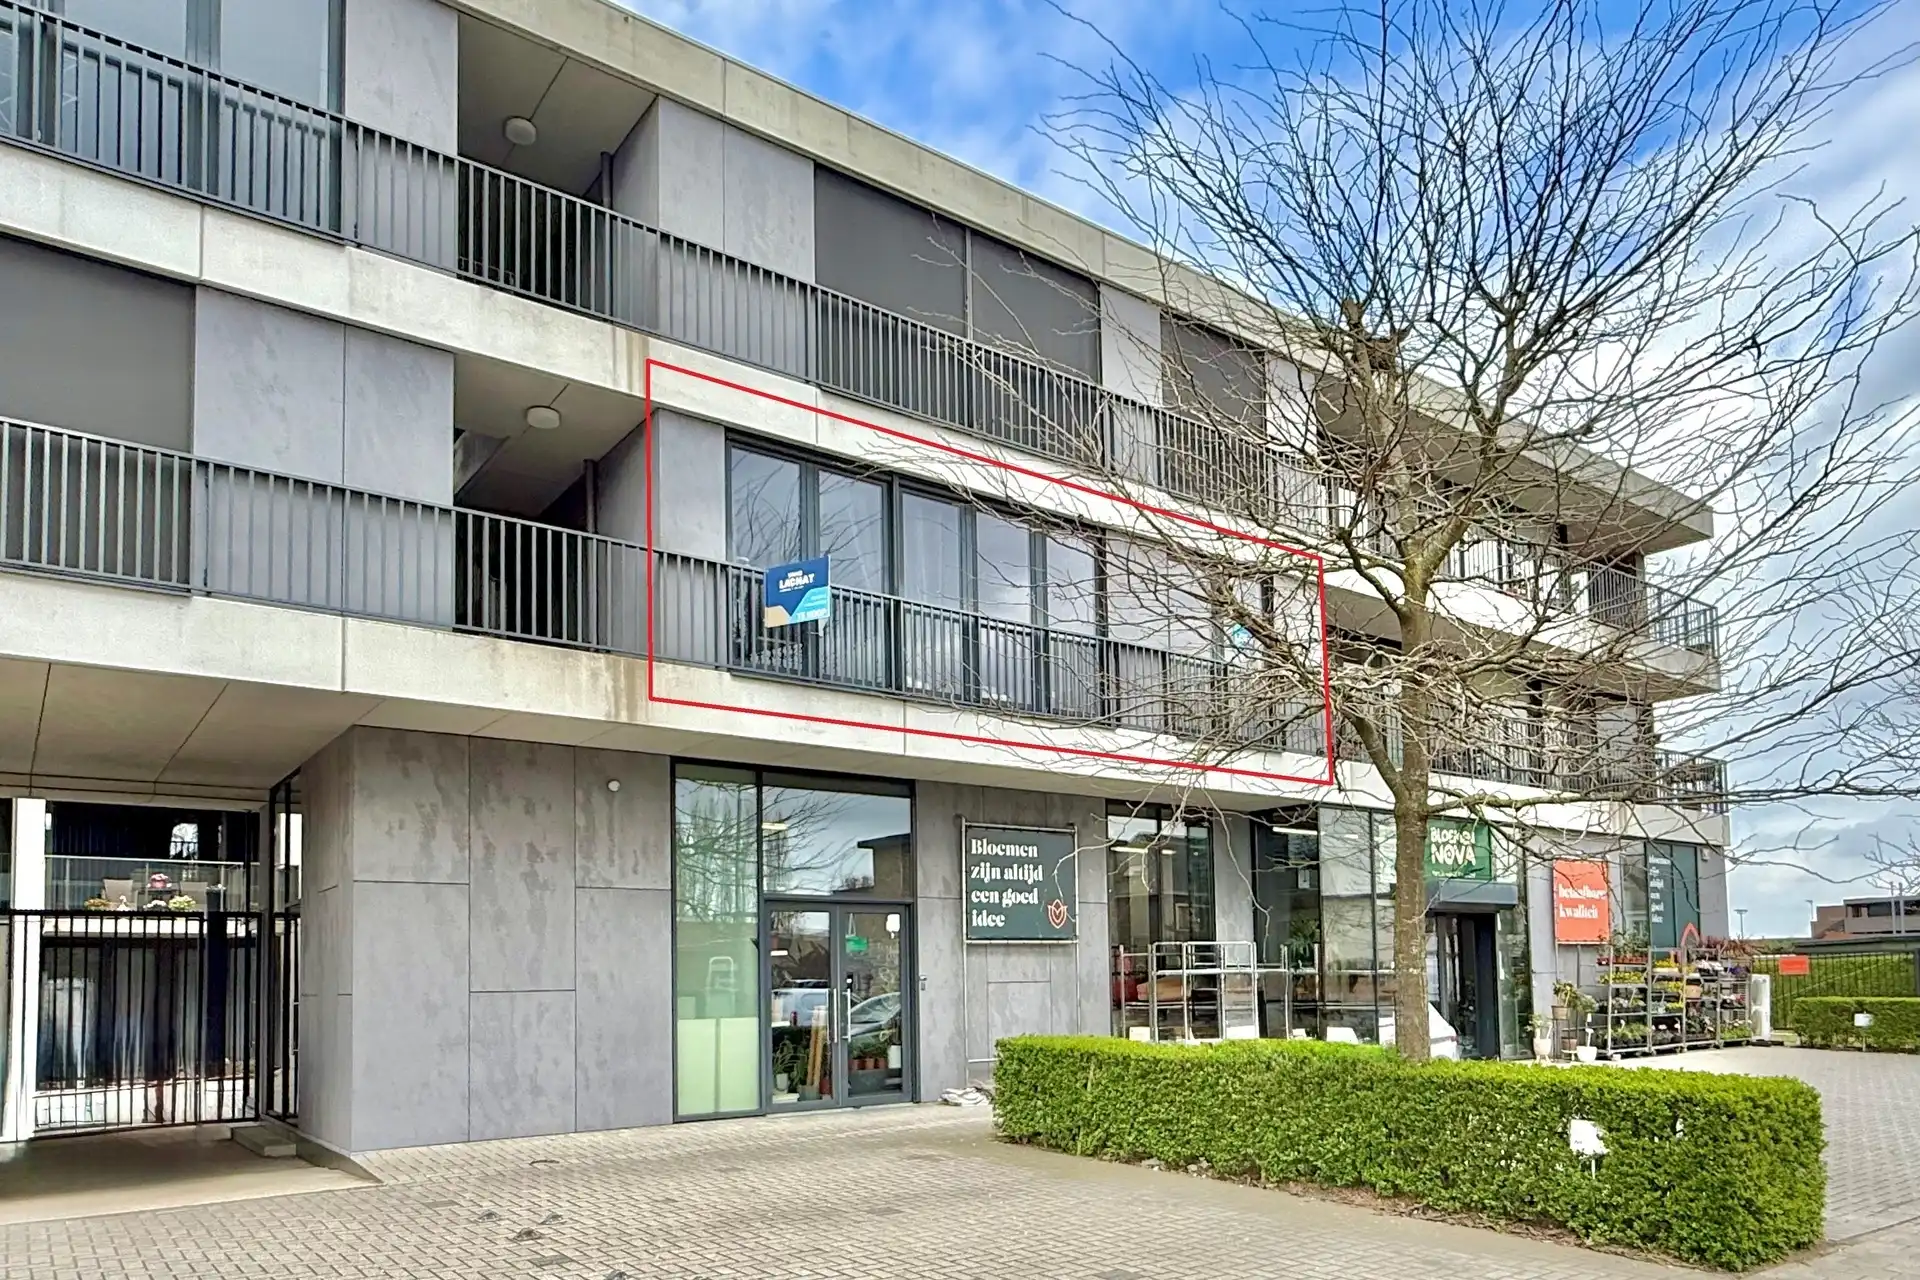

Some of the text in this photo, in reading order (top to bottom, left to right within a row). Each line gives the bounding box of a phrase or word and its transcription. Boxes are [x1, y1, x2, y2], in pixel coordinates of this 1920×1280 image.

[970, 838, 1038, 857] Bloemen
[1431, 843, 1476, 866] NOVA
[970, 862, 1043, 885] zijn altijd
[971, 888, 1038, 908] een goed
[972, 909, 1006, 927] idee
[1559, 903, 1599, 918] kwaliteit
